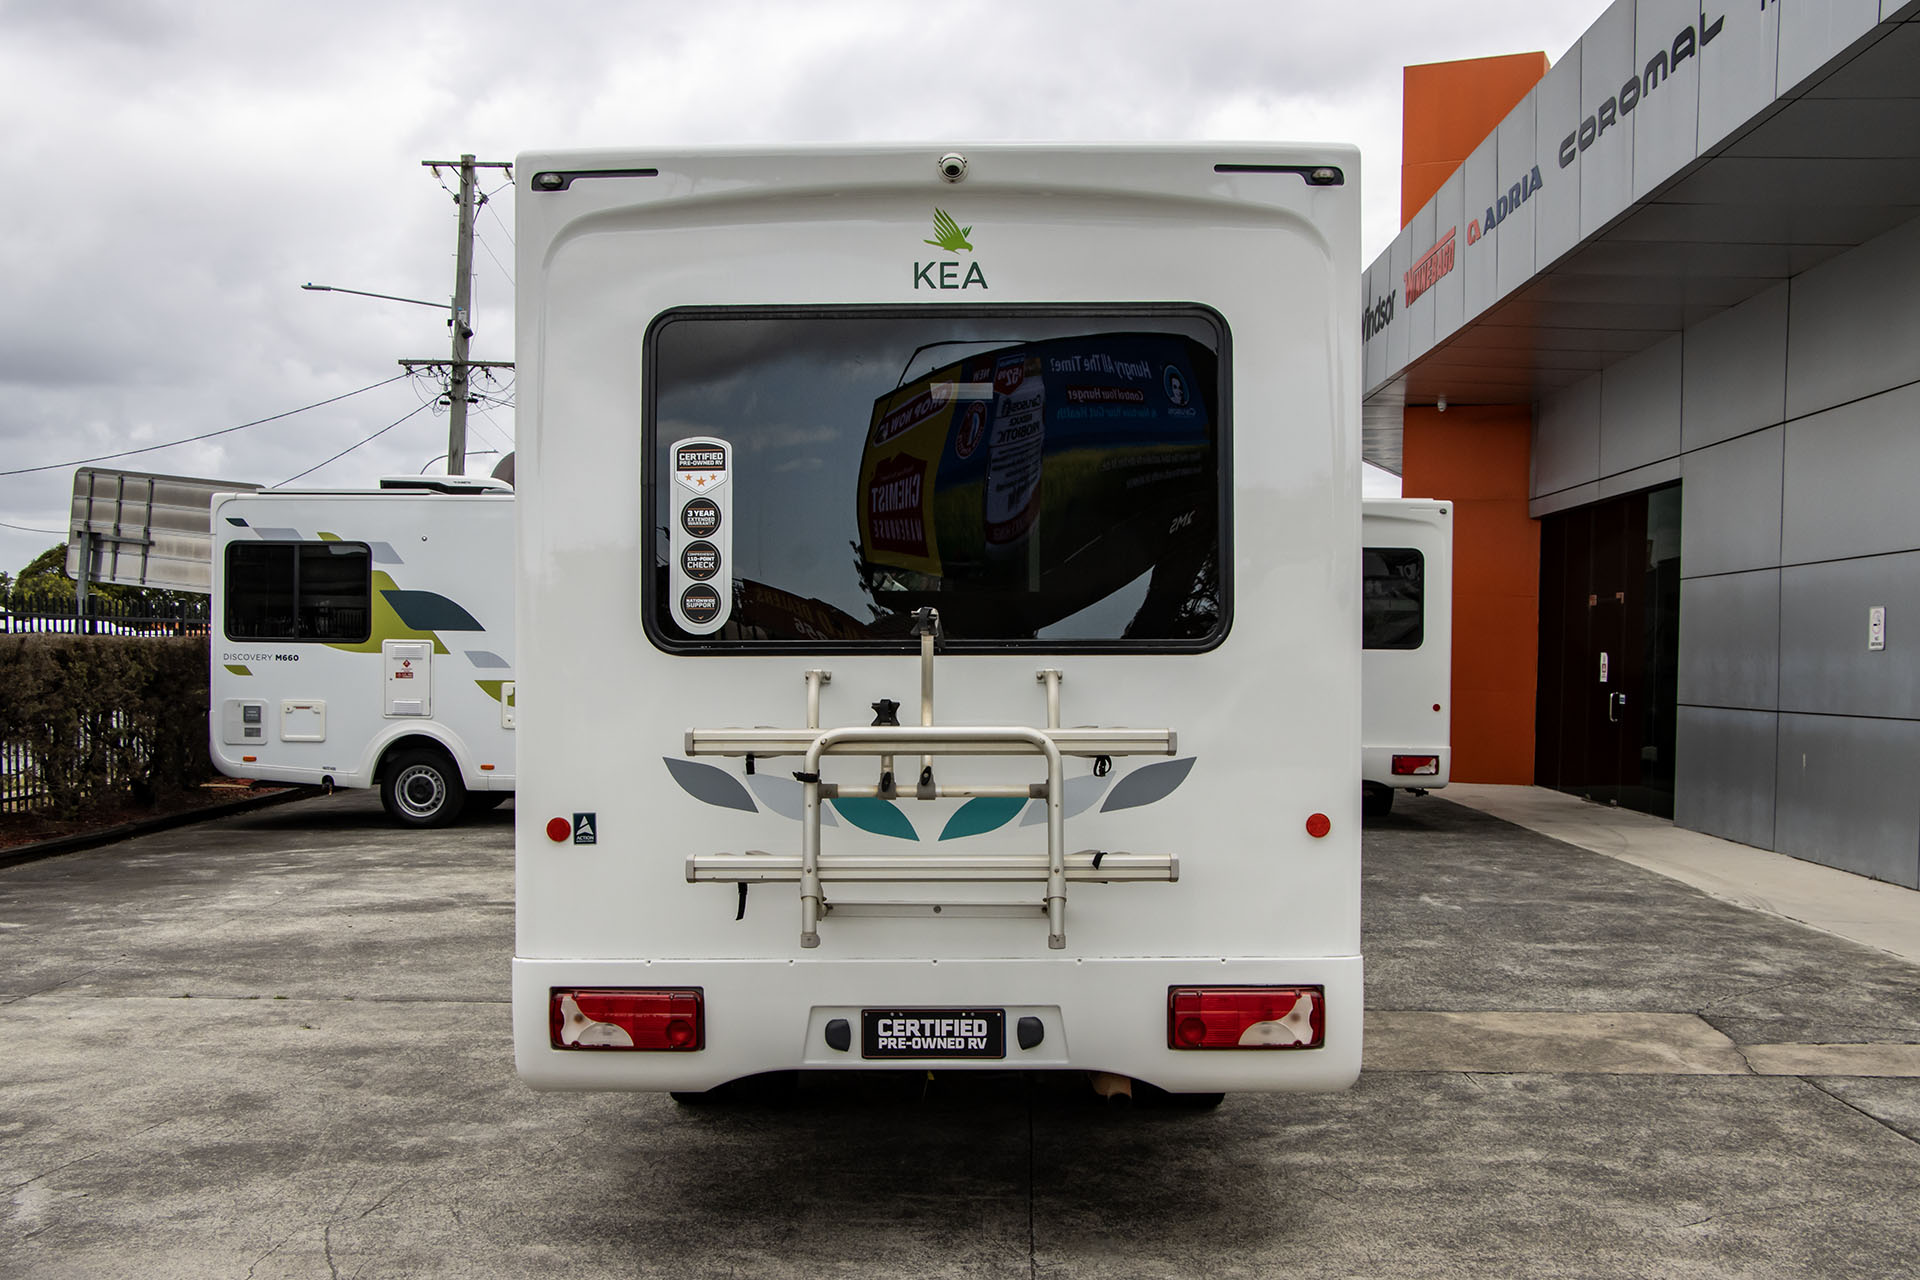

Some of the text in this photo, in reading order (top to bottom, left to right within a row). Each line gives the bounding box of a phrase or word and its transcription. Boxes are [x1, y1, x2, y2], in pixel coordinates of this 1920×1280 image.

[1558, 13, 1725, 169] COROMAL
[1483, 165, 1543, 236] ADRIA
[914, 261, 989, 290] KEA
[1404, 228, 1456, 309] WINNEBAGO
[679, 453, 723, 461] CERTIFIED
[223, 653, 273, 661] DISCOVERY
[877, 1019, 988, 1037] CERTIFIED
[878, 1037, 987, 1049] PRE-OWNED RV
